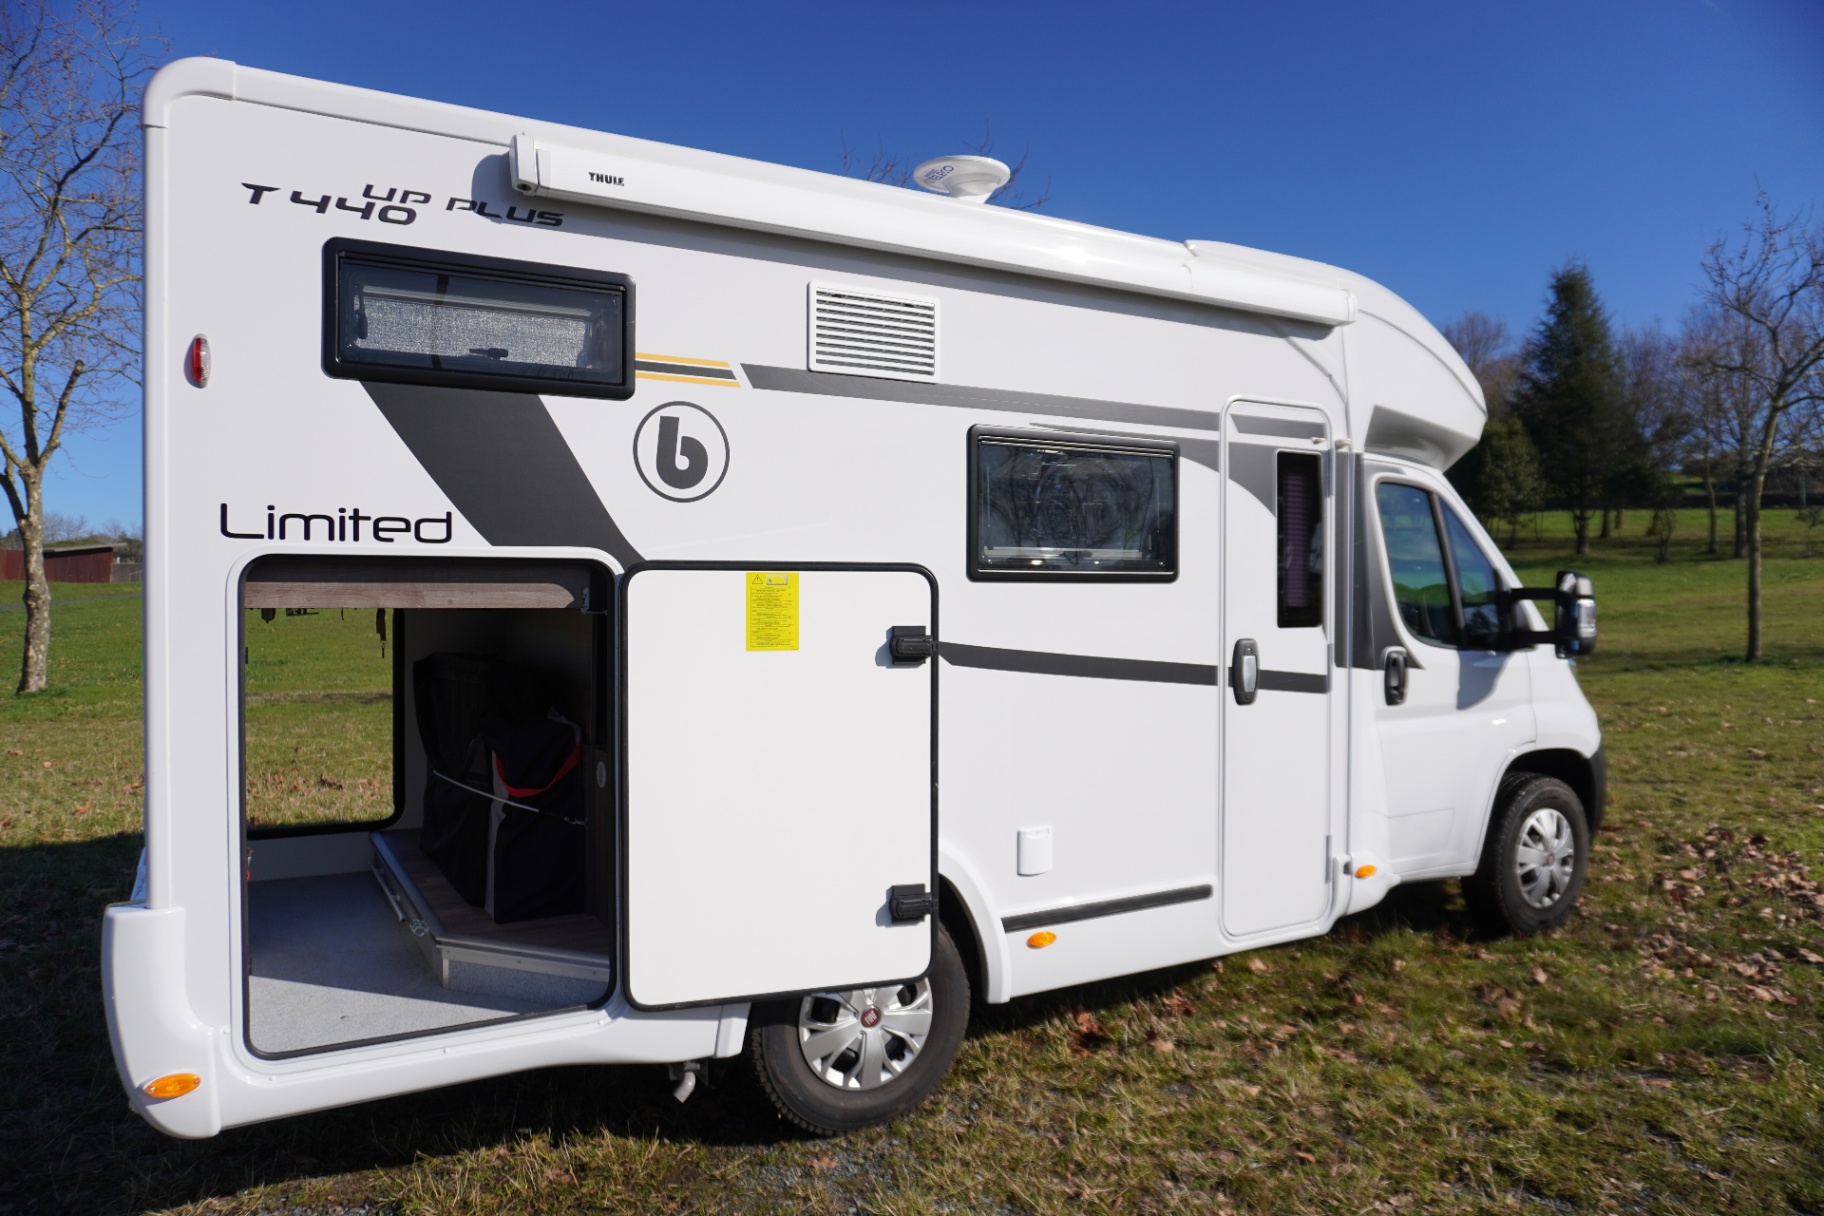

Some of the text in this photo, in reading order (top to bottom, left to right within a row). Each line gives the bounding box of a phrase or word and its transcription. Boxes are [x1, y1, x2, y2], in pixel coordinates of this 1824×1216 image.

[588, 171, 625, 187] THULE
[241, 182, 417, 226] T 440
[362, 184, 565, 227] UP PLUS
[220, 503, 453, 544] Limited
